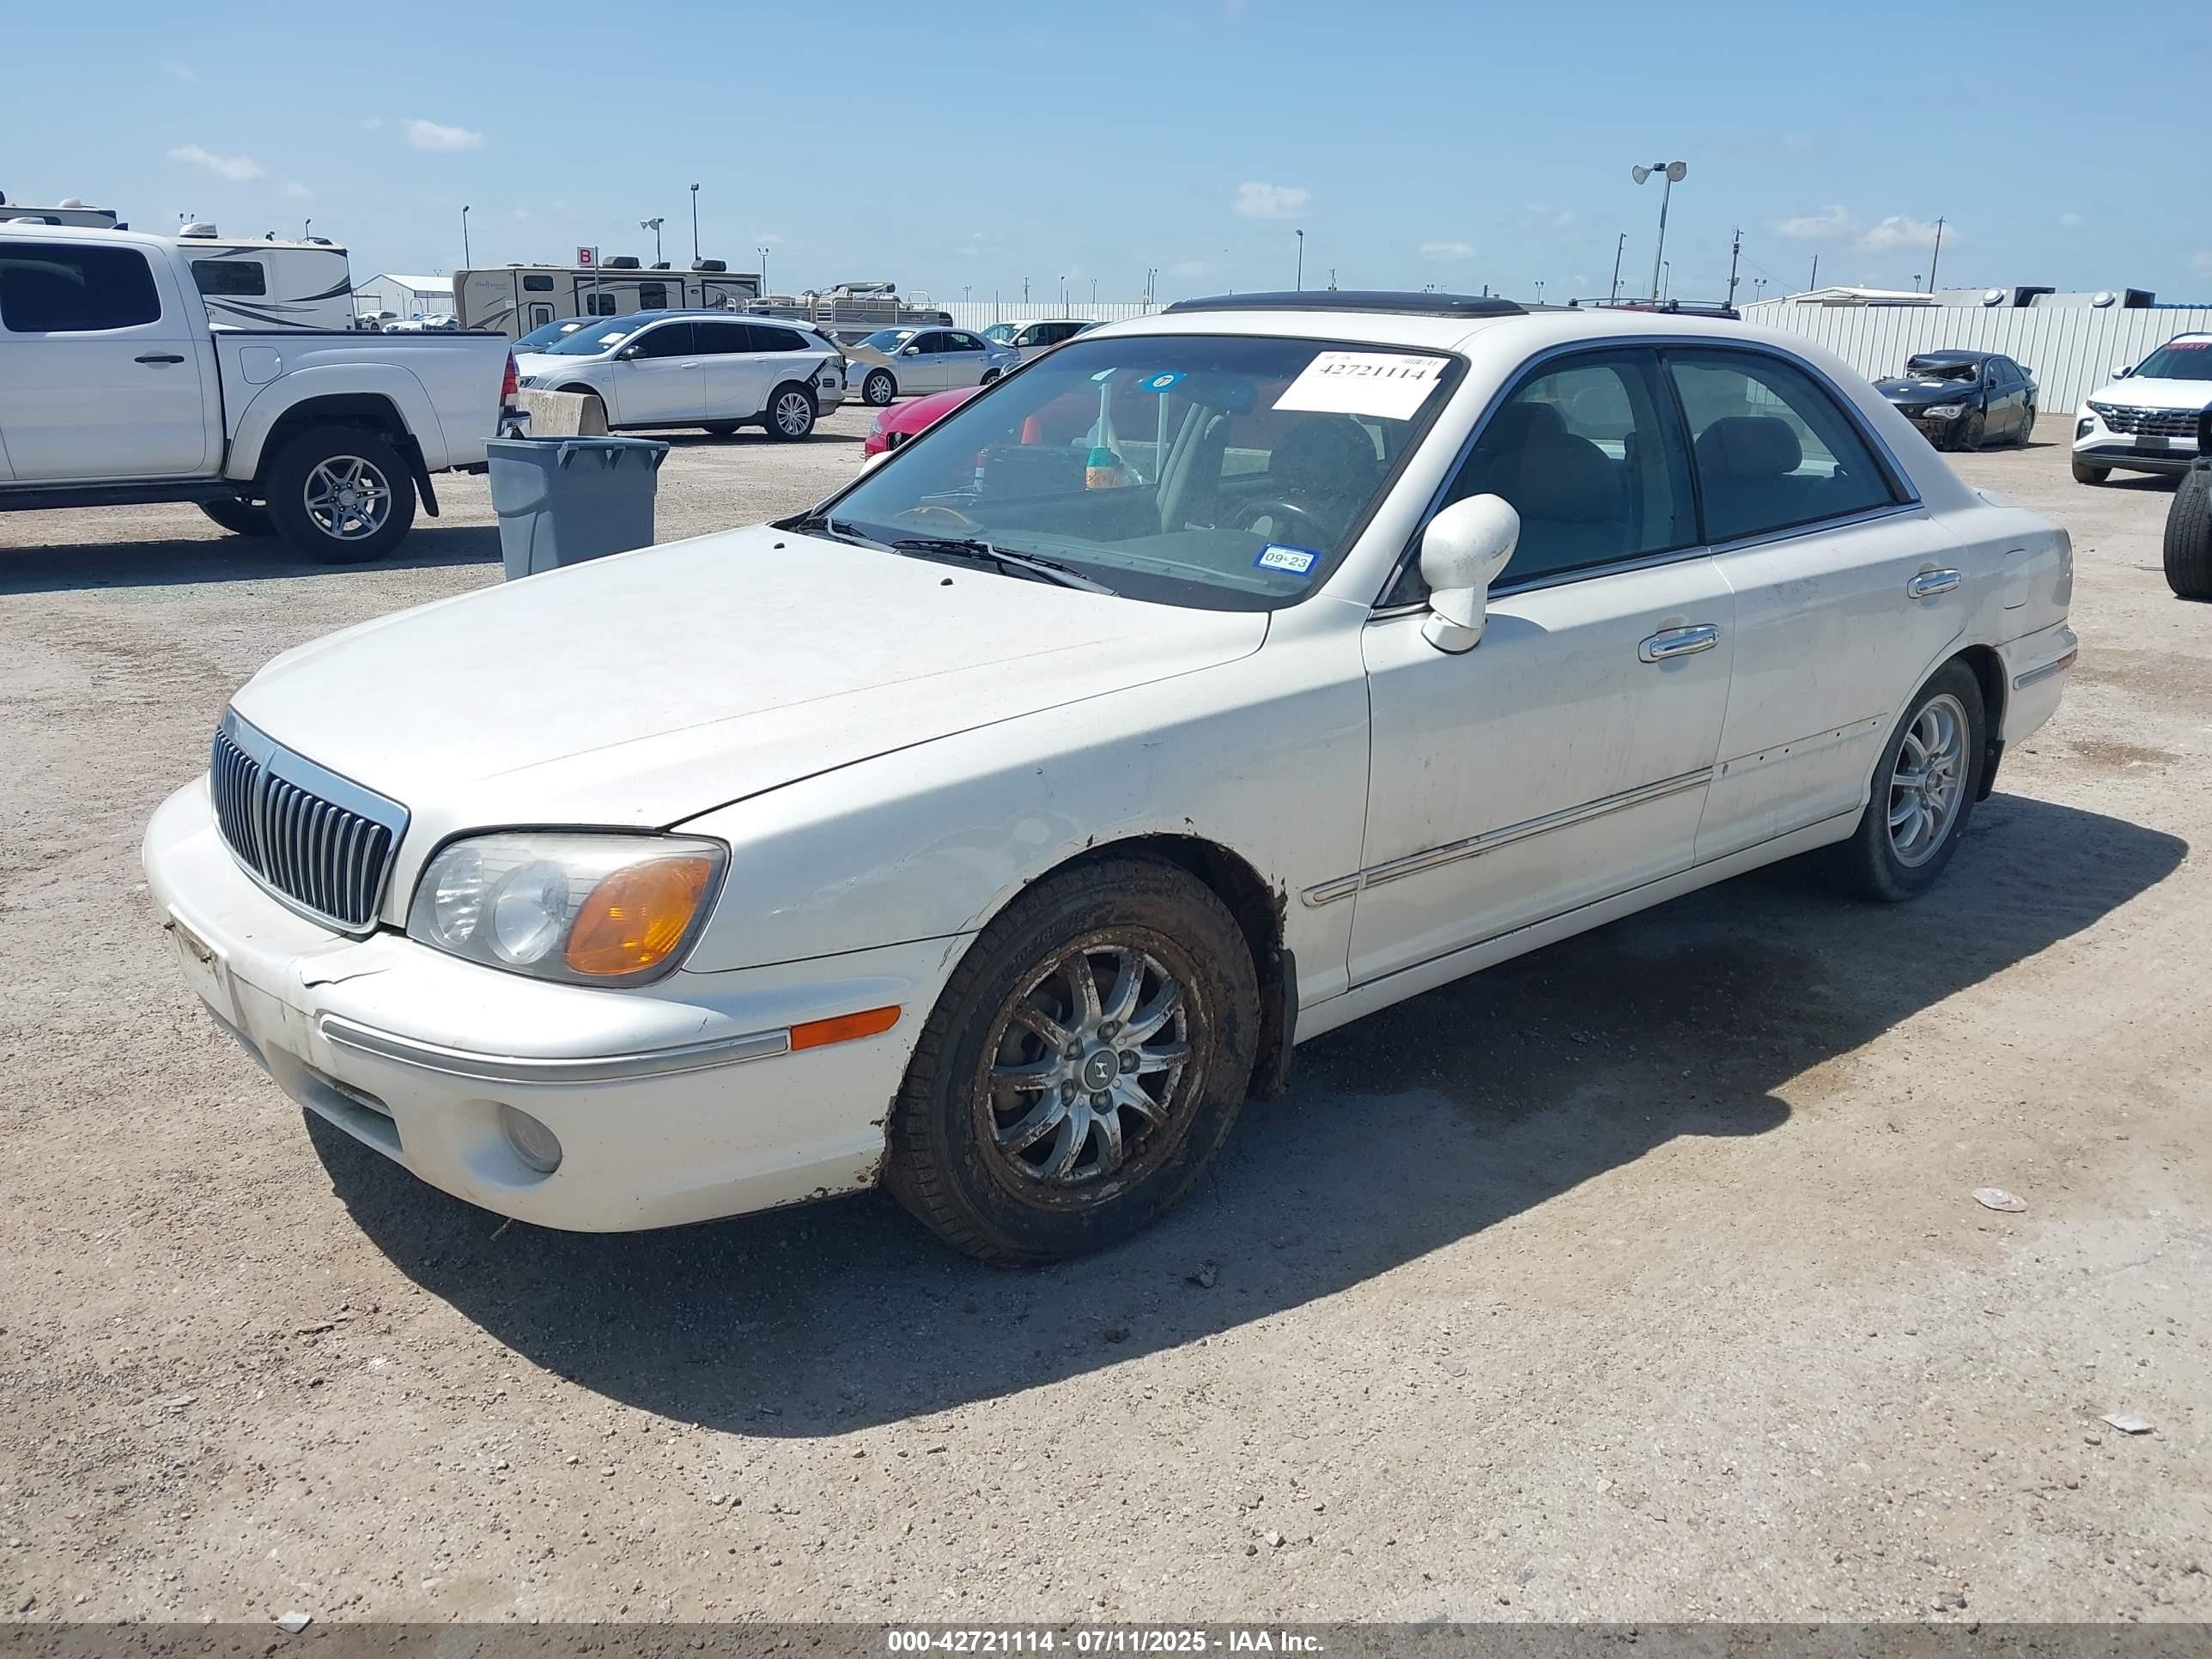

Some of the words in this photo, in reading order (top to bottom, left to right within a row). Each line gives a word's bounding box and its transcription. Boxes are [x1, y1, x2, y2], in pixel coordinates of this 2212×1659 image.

[580, 249, 592, 263] B
[1319, 363, 1427, 380] 42721114
[1265, 552, 1284, 563] 09
[1288, 556, 1309, 568] 23
